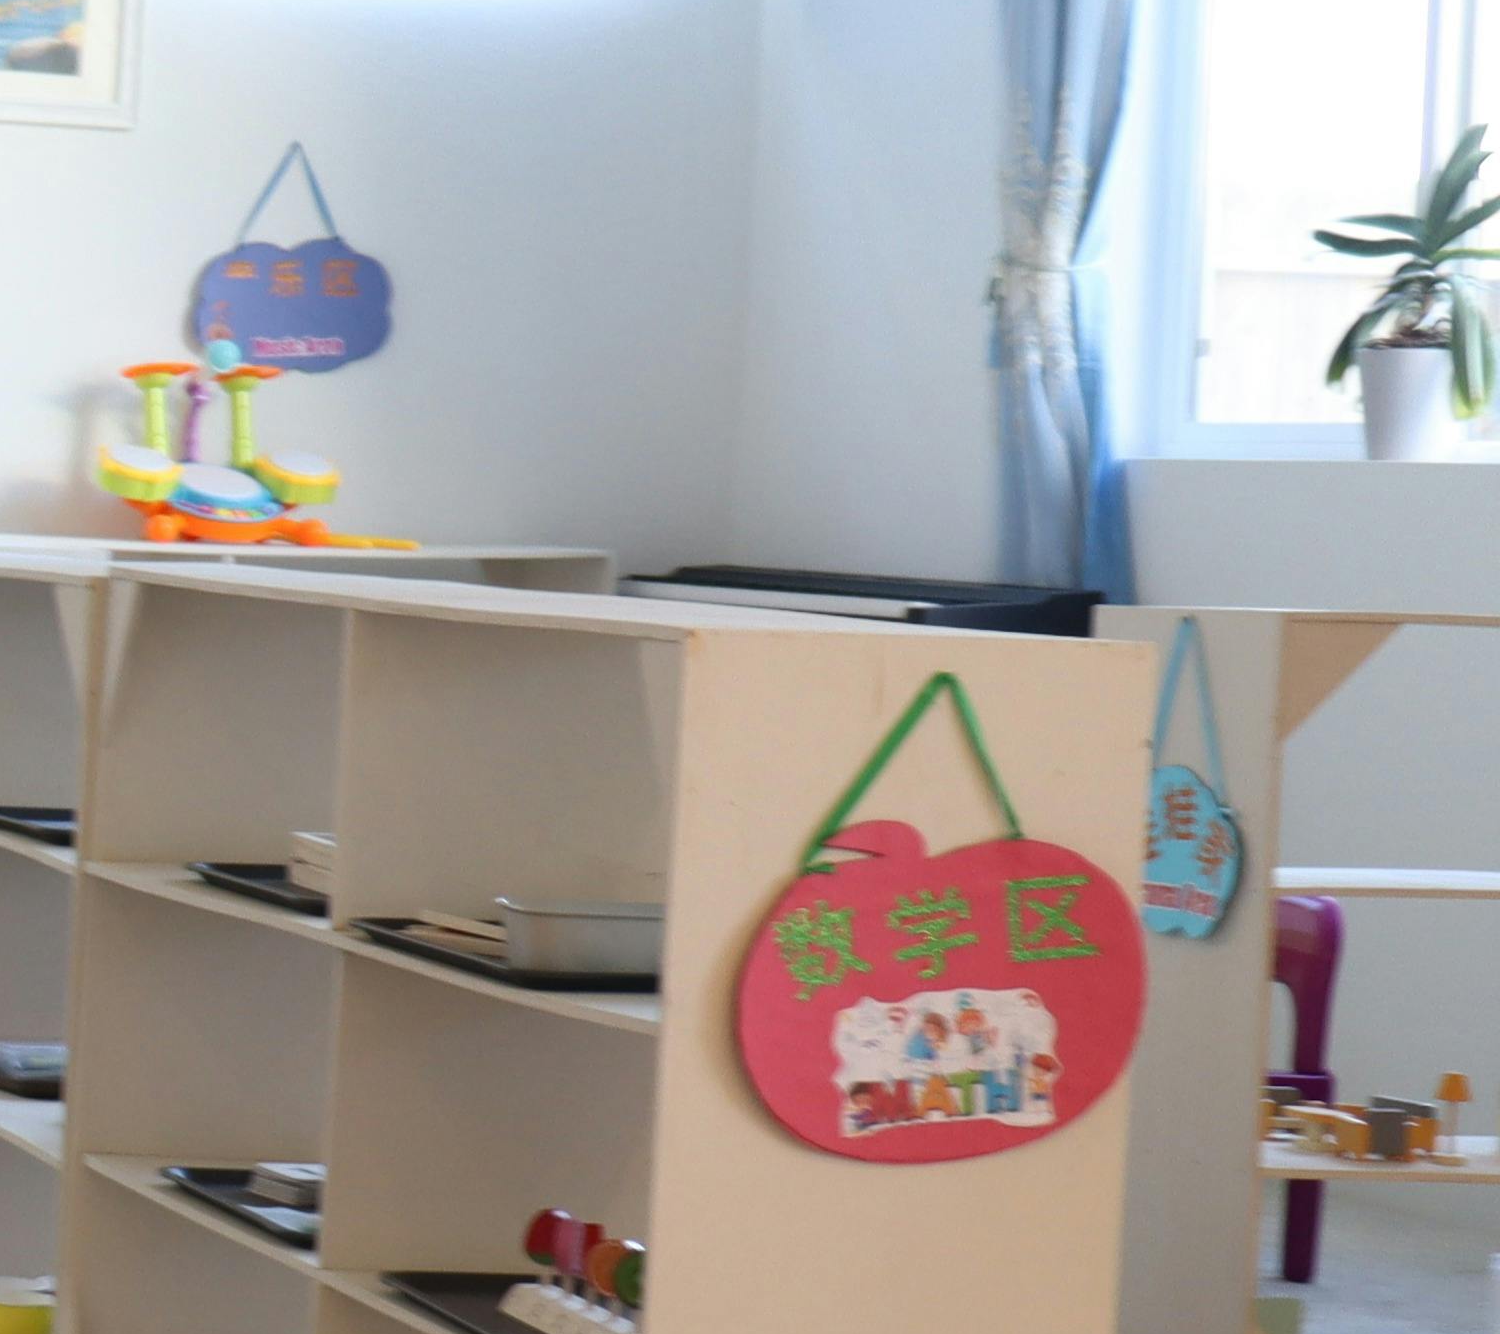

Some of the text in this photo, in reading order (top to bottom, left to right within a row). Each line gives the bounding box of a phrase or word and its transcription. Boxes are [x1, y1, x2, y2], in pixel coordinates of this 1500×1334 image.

[771, 876, 1102, 1002] 数学区
[868, 1069, 1021, 1123] MATH
